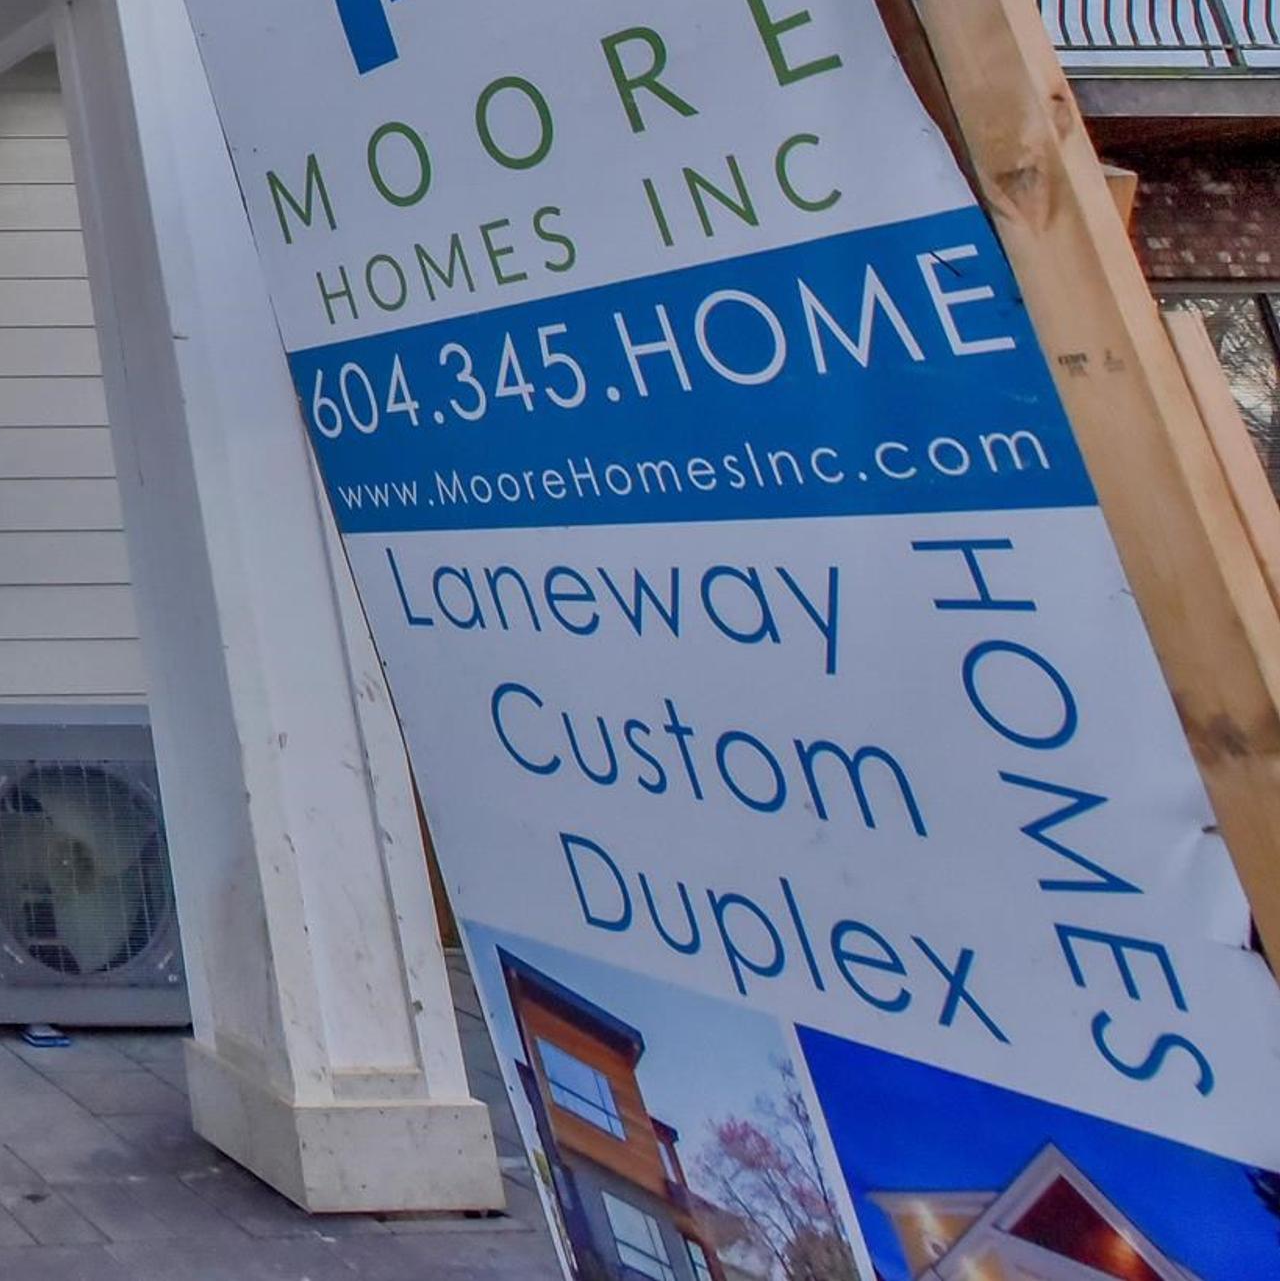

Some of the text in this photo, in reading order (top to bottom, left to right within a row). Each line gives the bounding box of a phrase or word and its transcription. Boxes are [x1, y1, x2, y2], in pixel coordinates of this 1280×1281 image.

[315, 133, 842, 325] HOMES INC
[311, 244, 1017, 440] 604.345.HOME
[338, 427, 1050, 510] www.MooreHomesInc.com
[385, 547, 840, 676] Laneway
[490, 681, 928, 838] Custom
[911, 537, 1215, 1097] HOMES
[559, 832, 1011, 1045] Duplex
